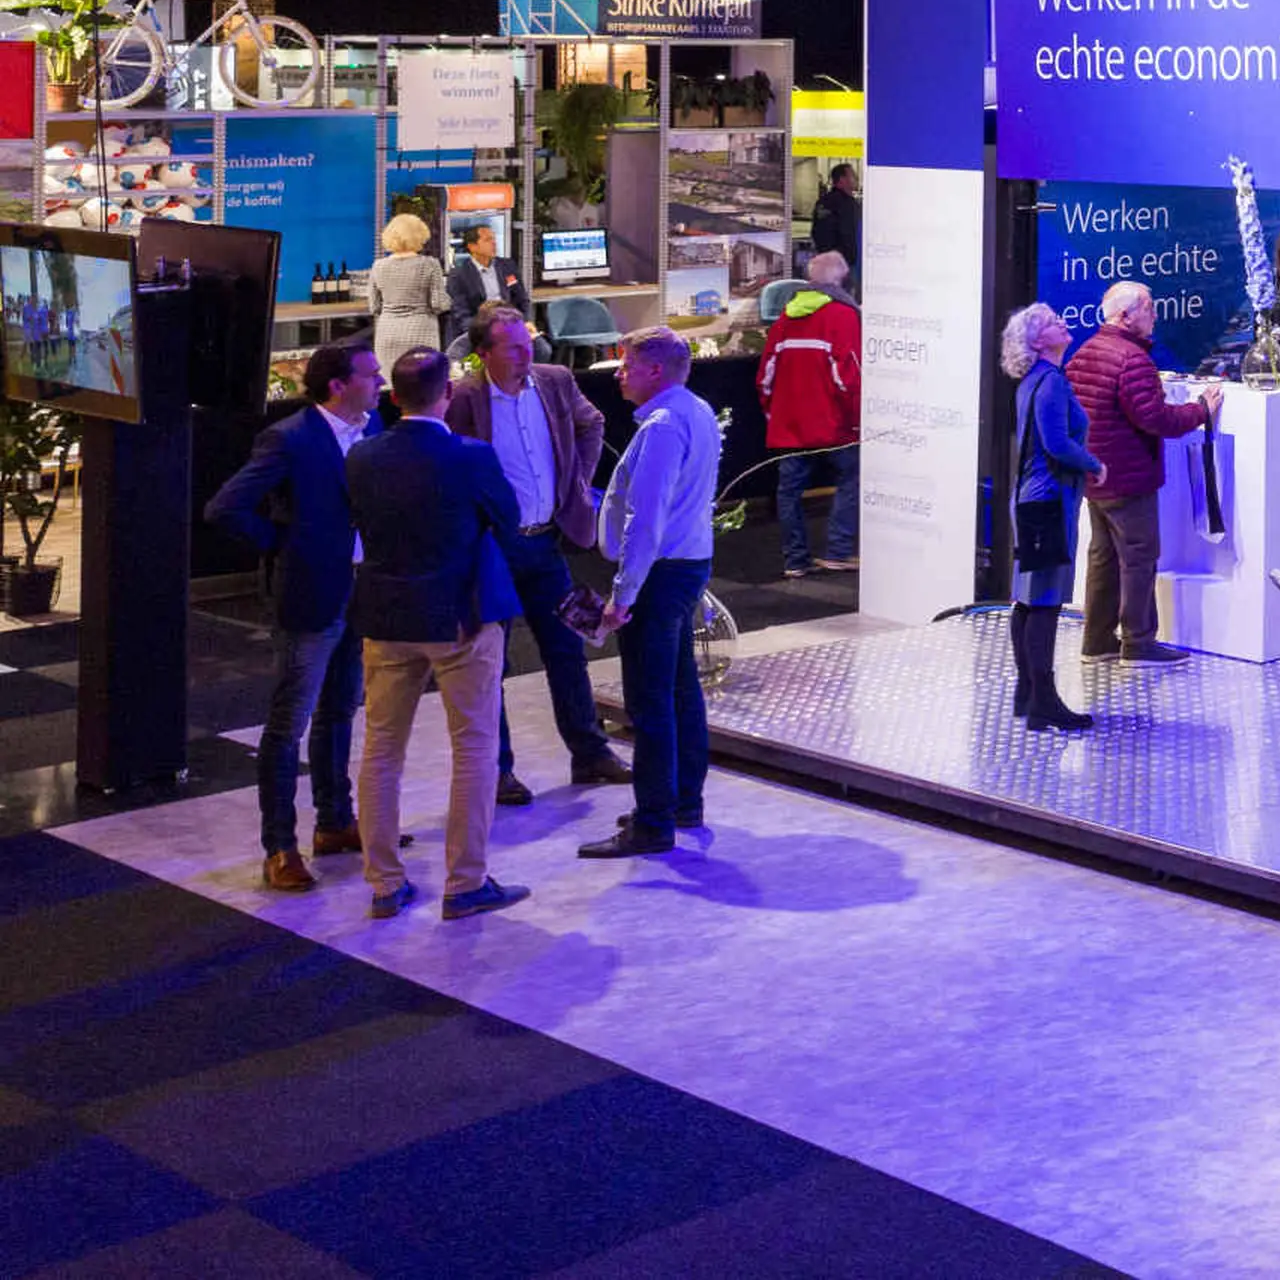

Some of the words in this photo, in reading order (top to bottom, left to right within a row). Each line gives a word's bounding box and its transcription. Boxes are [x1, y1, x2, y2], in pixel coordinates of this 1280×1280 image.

[1035, 32, 1125, 81] echte
[1062, 199, 1169, 233] Werken
[1062, 251, 1088, 282] in
[1097, 246, 1133, 280] de
[1141, 241, 1218, 276] echte
